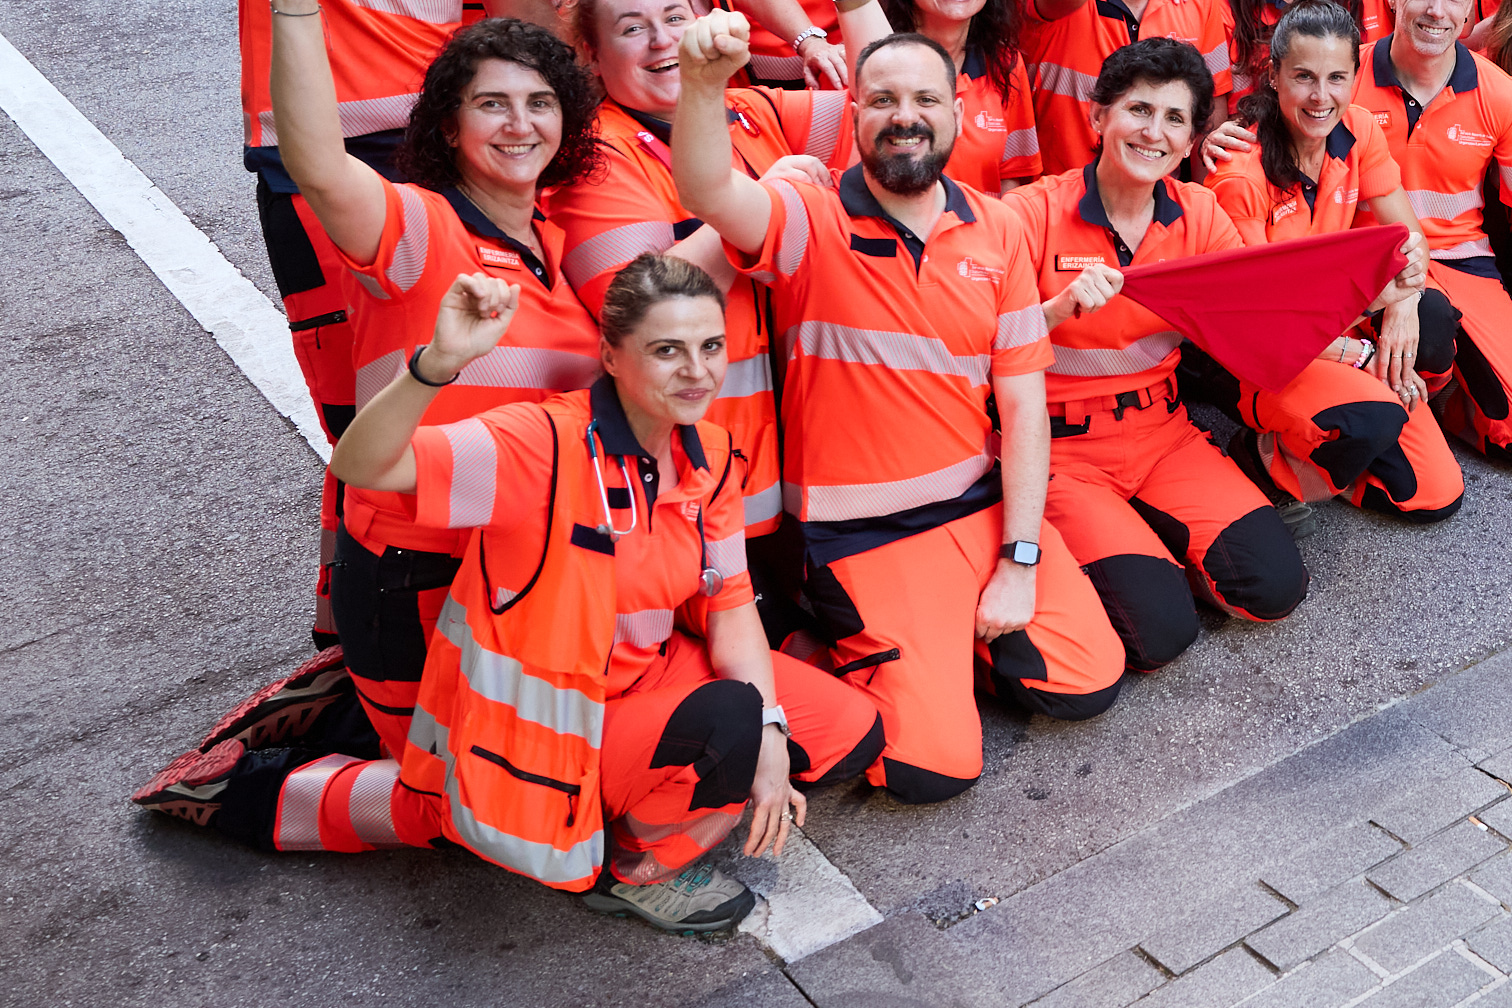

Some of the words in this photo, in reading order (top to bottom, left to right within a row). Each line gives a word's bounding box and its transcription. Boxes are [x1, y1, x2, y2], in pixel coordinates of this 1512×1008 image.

[479, 246, 520, 259] ENFERMERÍA
[483, 253, 520, 266] ERIZAINTZA
[1060, 255, 1105, 264] ENFERMERÍA
